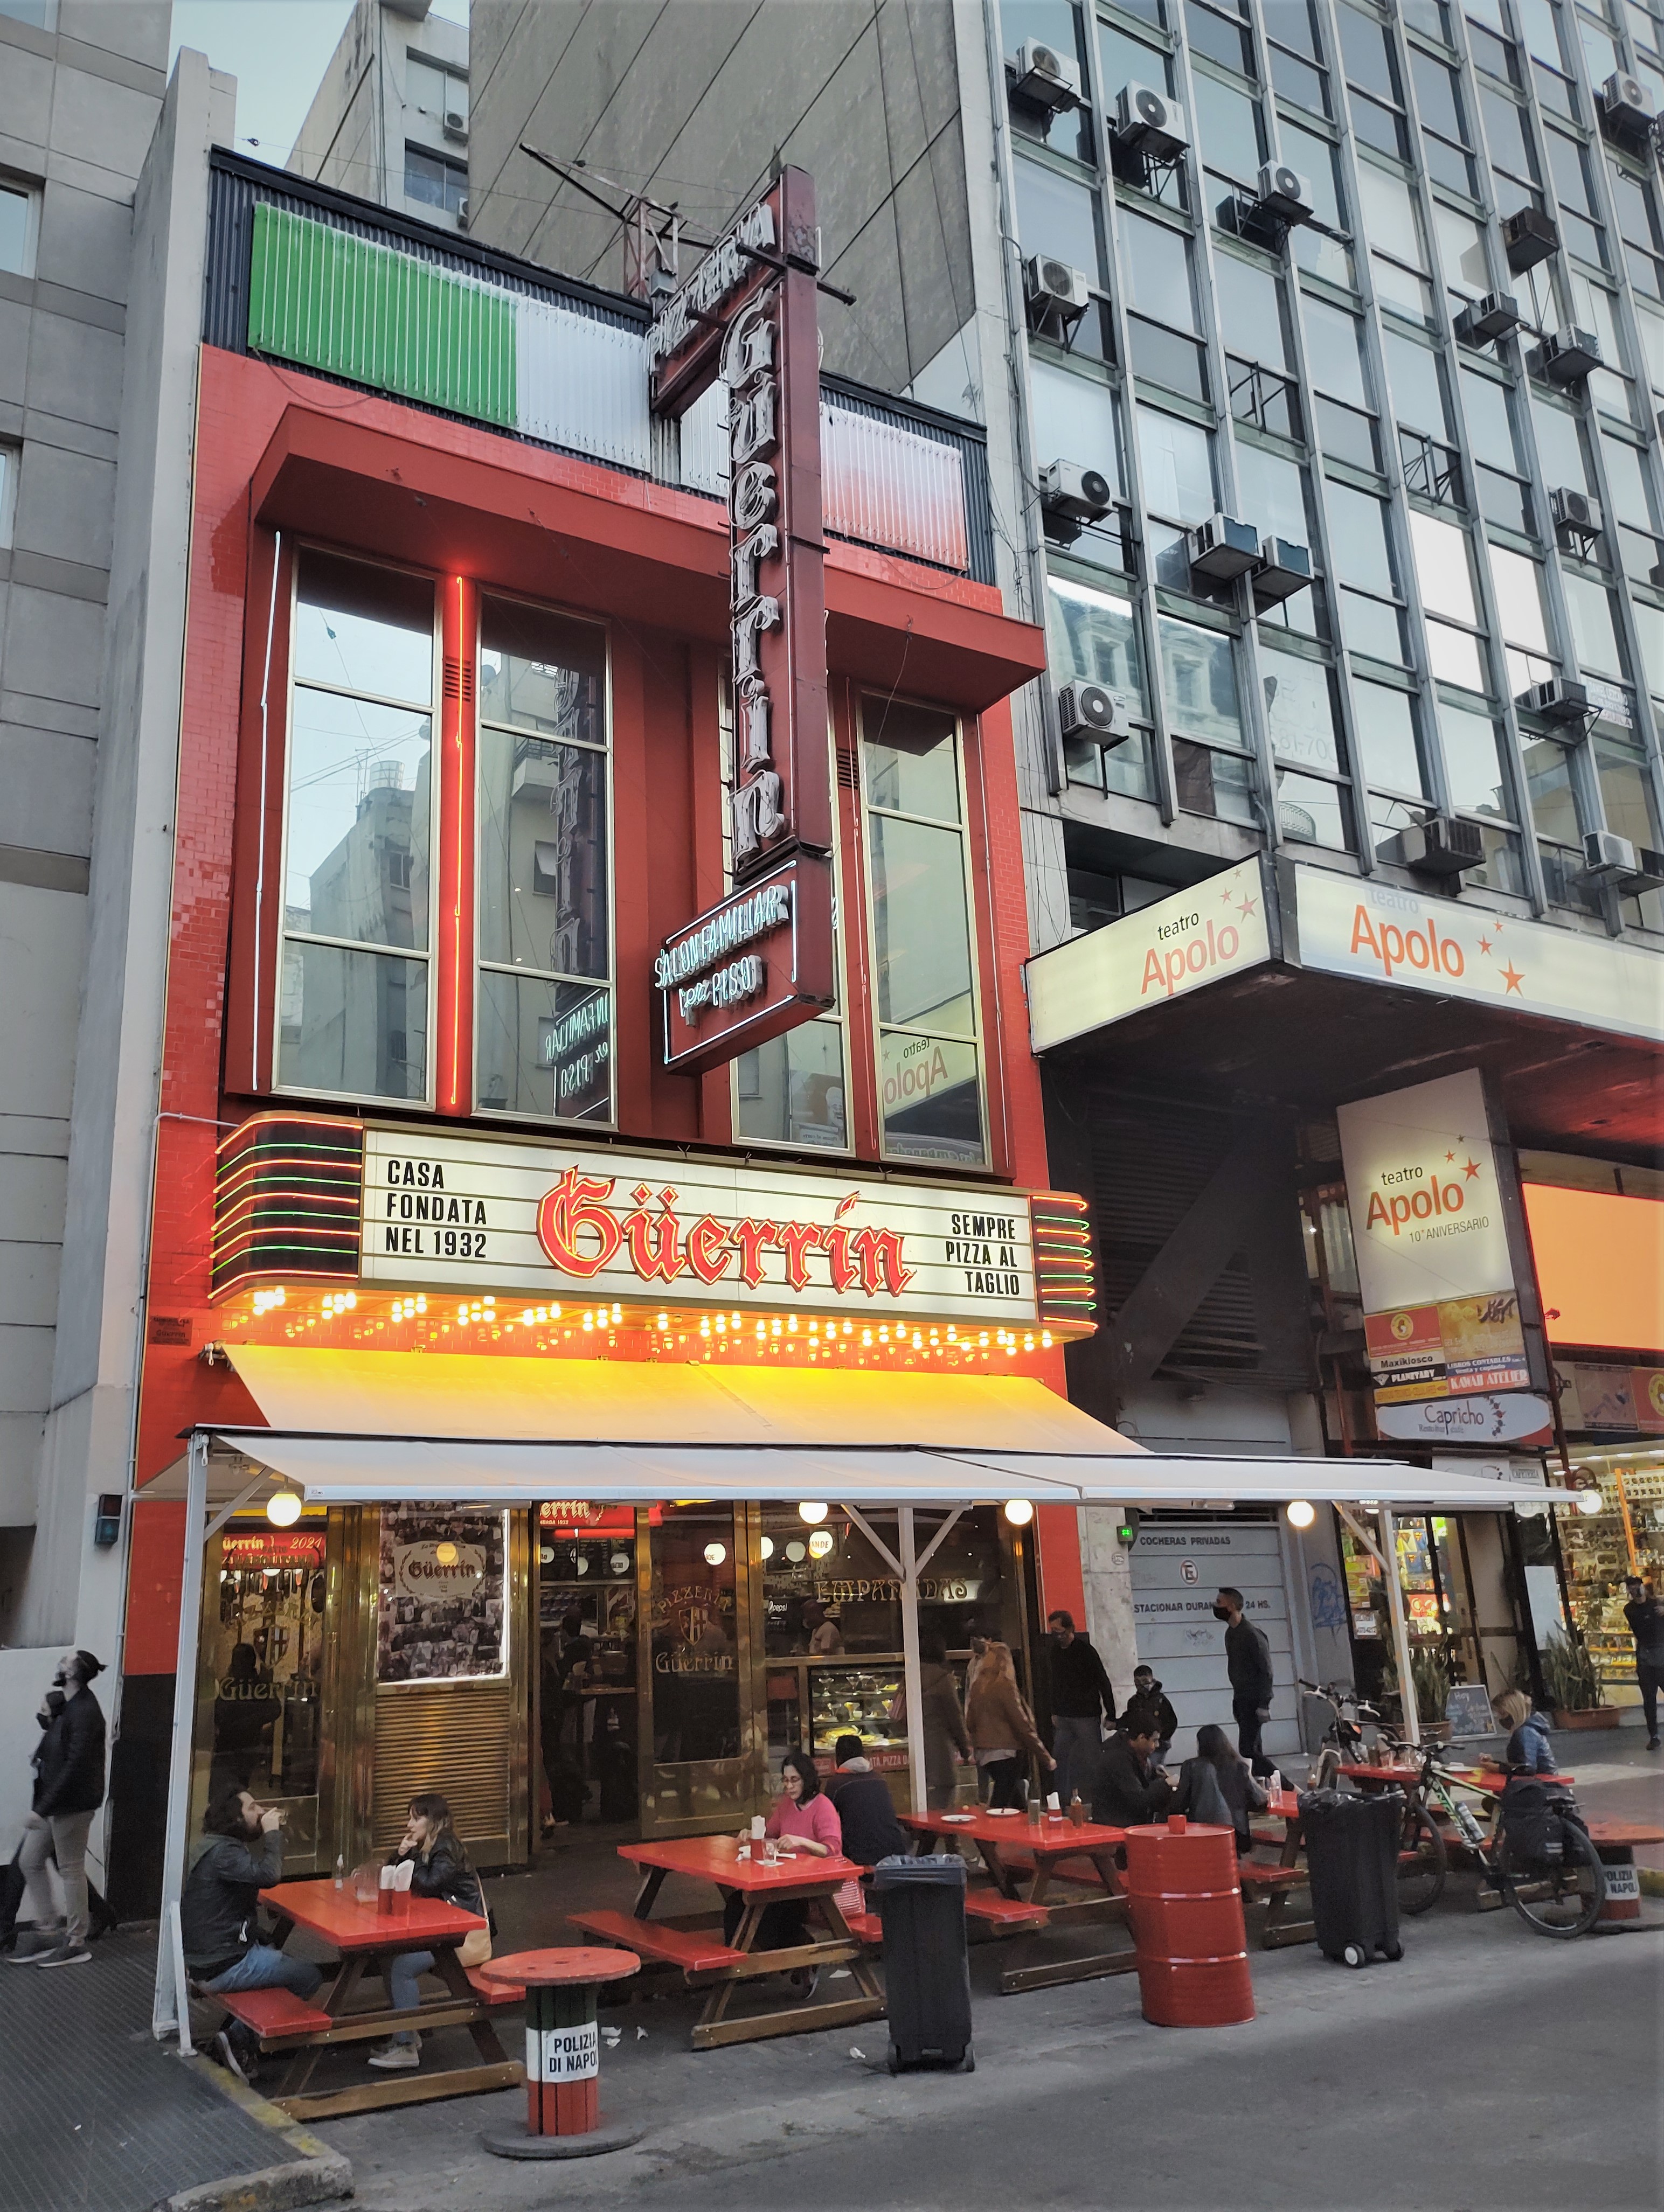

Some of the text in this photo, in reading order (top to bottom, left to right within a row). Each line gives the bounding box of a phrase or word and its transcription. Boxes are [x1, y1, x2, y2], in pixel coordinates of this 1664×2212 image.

[1369, 886, 1420, 915] teatro
[702, 885, 789, 960] FAMILIAR
[1157, 911, 1200, 941] teatro
[1350, 903, 1465, 977] Apolo
[1140, 919, 1239, 996] Apolo
[712, 955, 763, 1007] PISO
[387, 1159, 445, 1190] CASA
[1381, 1165, 1423, 1186] teatro
[386, 1193, 487, 1226] FONDATA
[1365, 1174, 1464, 1236] Apolo
[536, 1164, 918, 1299] Güerrín
[951, 1213, 1016, 1240] SEMPRE
[1426, 1215, 1489, 1241] ANIVERSARIO
[385, 1227, 487, 1258] NEL 1932
[945, 1241, 1018, 1268] PIZZA AL
[964, 1270, 1020, 1296] TAGLIO
[1424, 1400, 1484, 1436] Capricho
[289, 1536, 323, 1549] 2021
[1140, 1536, 1231, 1546] COCHERAS PRIVADAS
[1184, 1564, 1194, 1580] E
[1134, 1602, 1183, 1613] STACIONAR
[1185, 1601, 1214, 1611] DURAN
[1245, 1601, 1256, 1609] 24
[549, 2056, 561, 2072] DI
